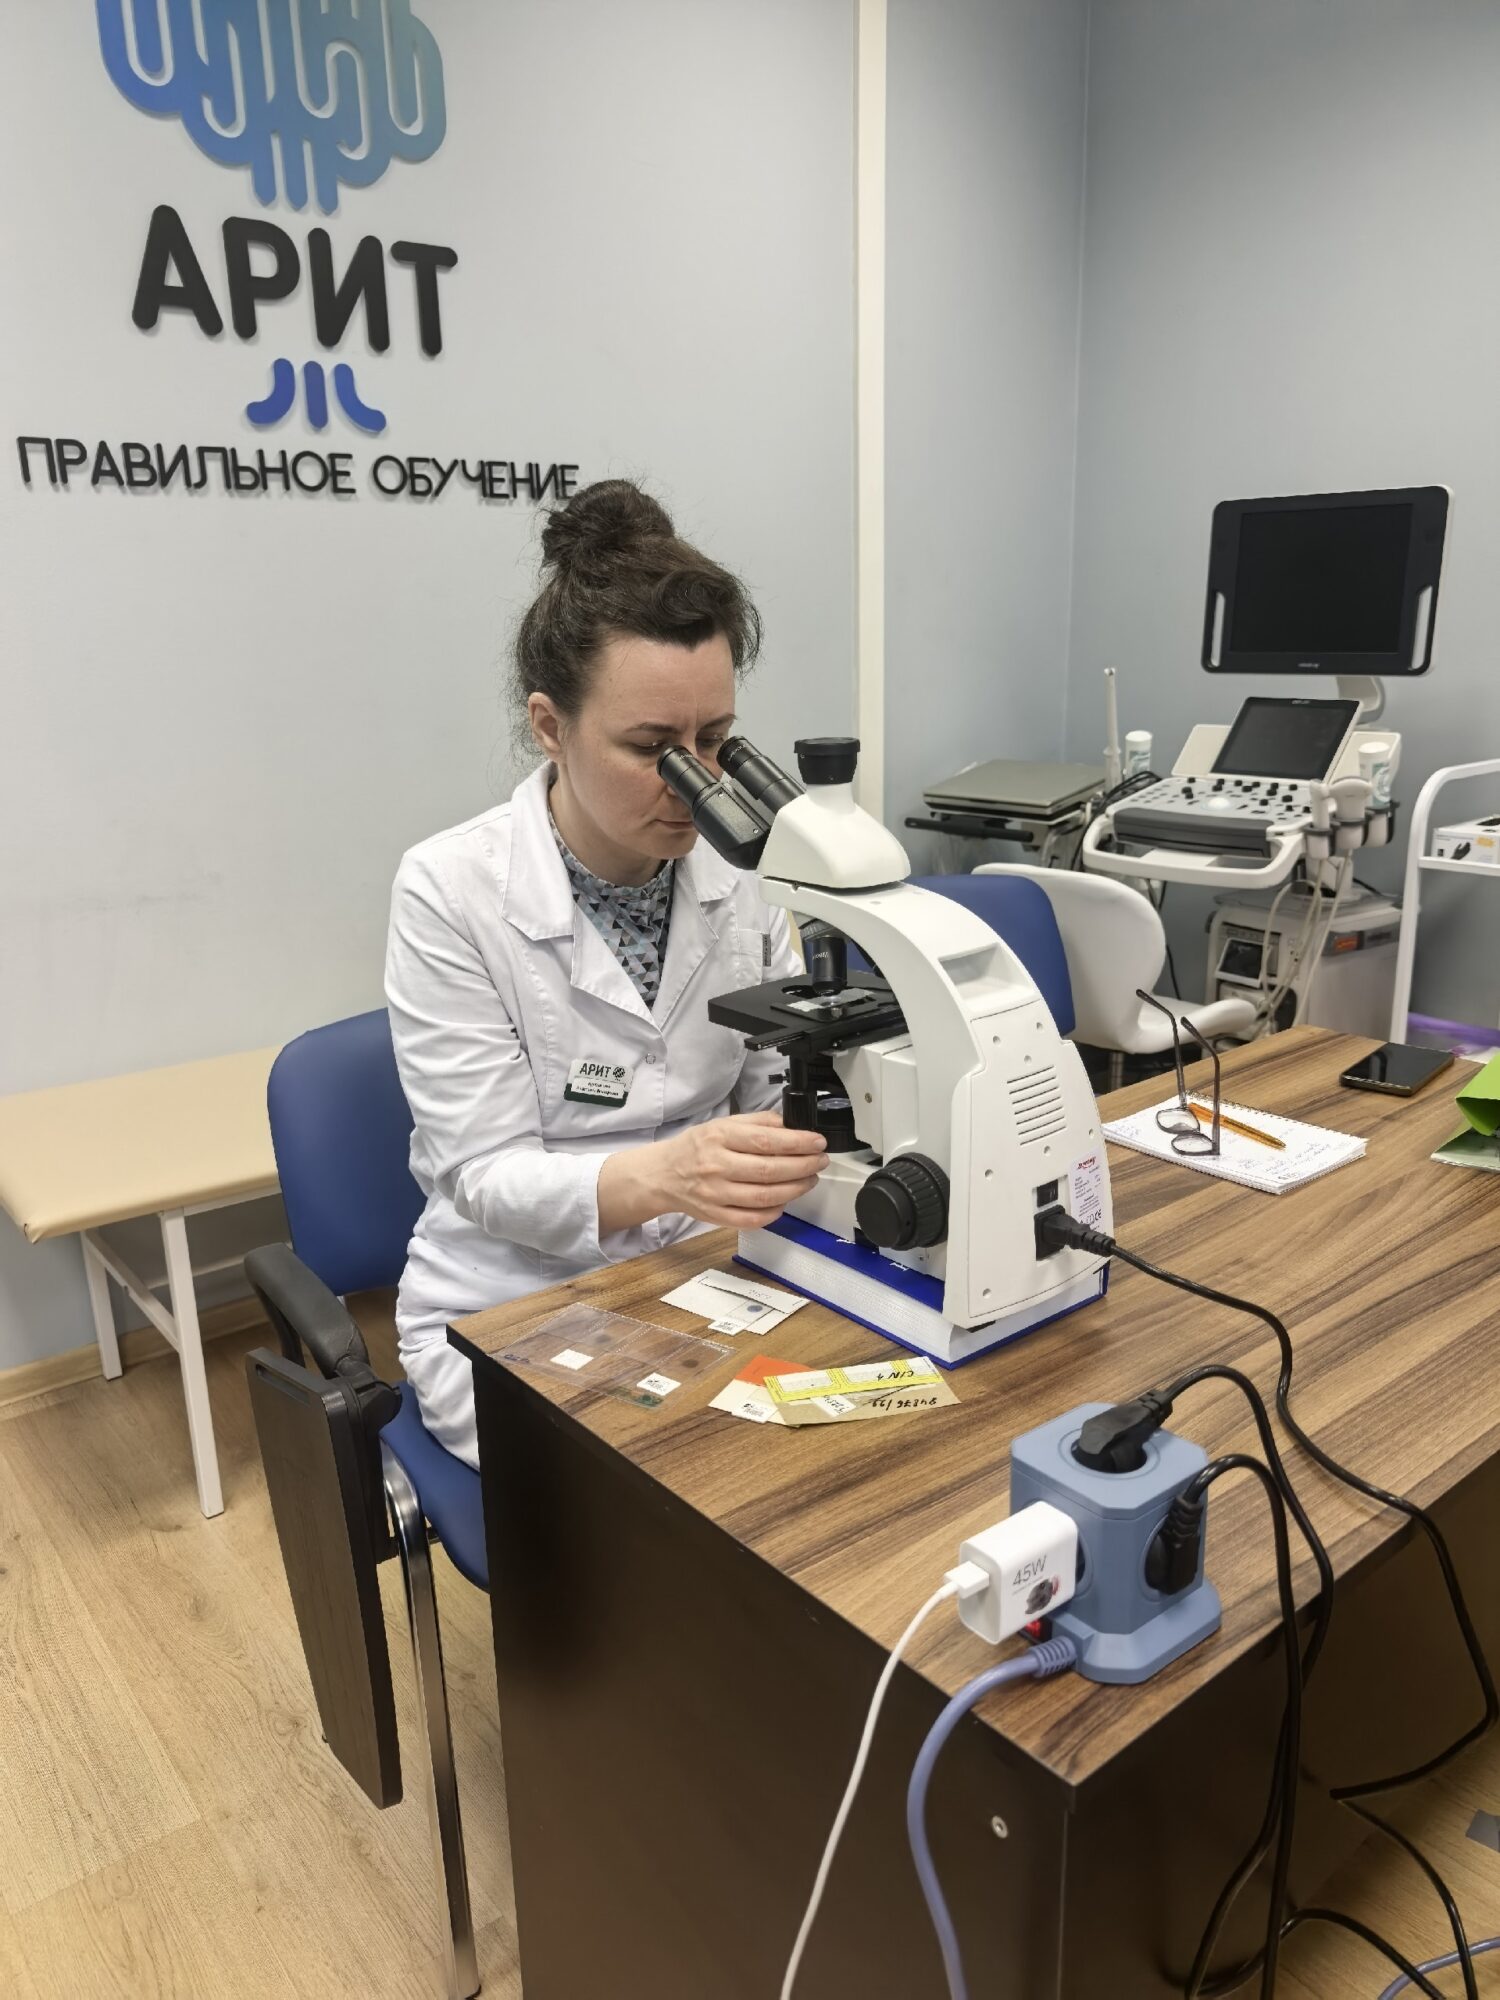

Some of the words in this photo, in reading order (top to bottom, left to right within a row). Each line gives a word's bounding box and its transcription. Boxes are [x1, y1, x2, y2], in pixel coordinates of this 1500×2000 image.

[132, 204, 458, 357] АРИТ
[17, 436, 357, 494] ПРАВИЛЬНОЕ
[372, 455, 580, 501] ОБУЧЕНИЕ
[579, 1062, 612, 1078] АРИТ
[1012, 1554, 1047, 1586] 45W
